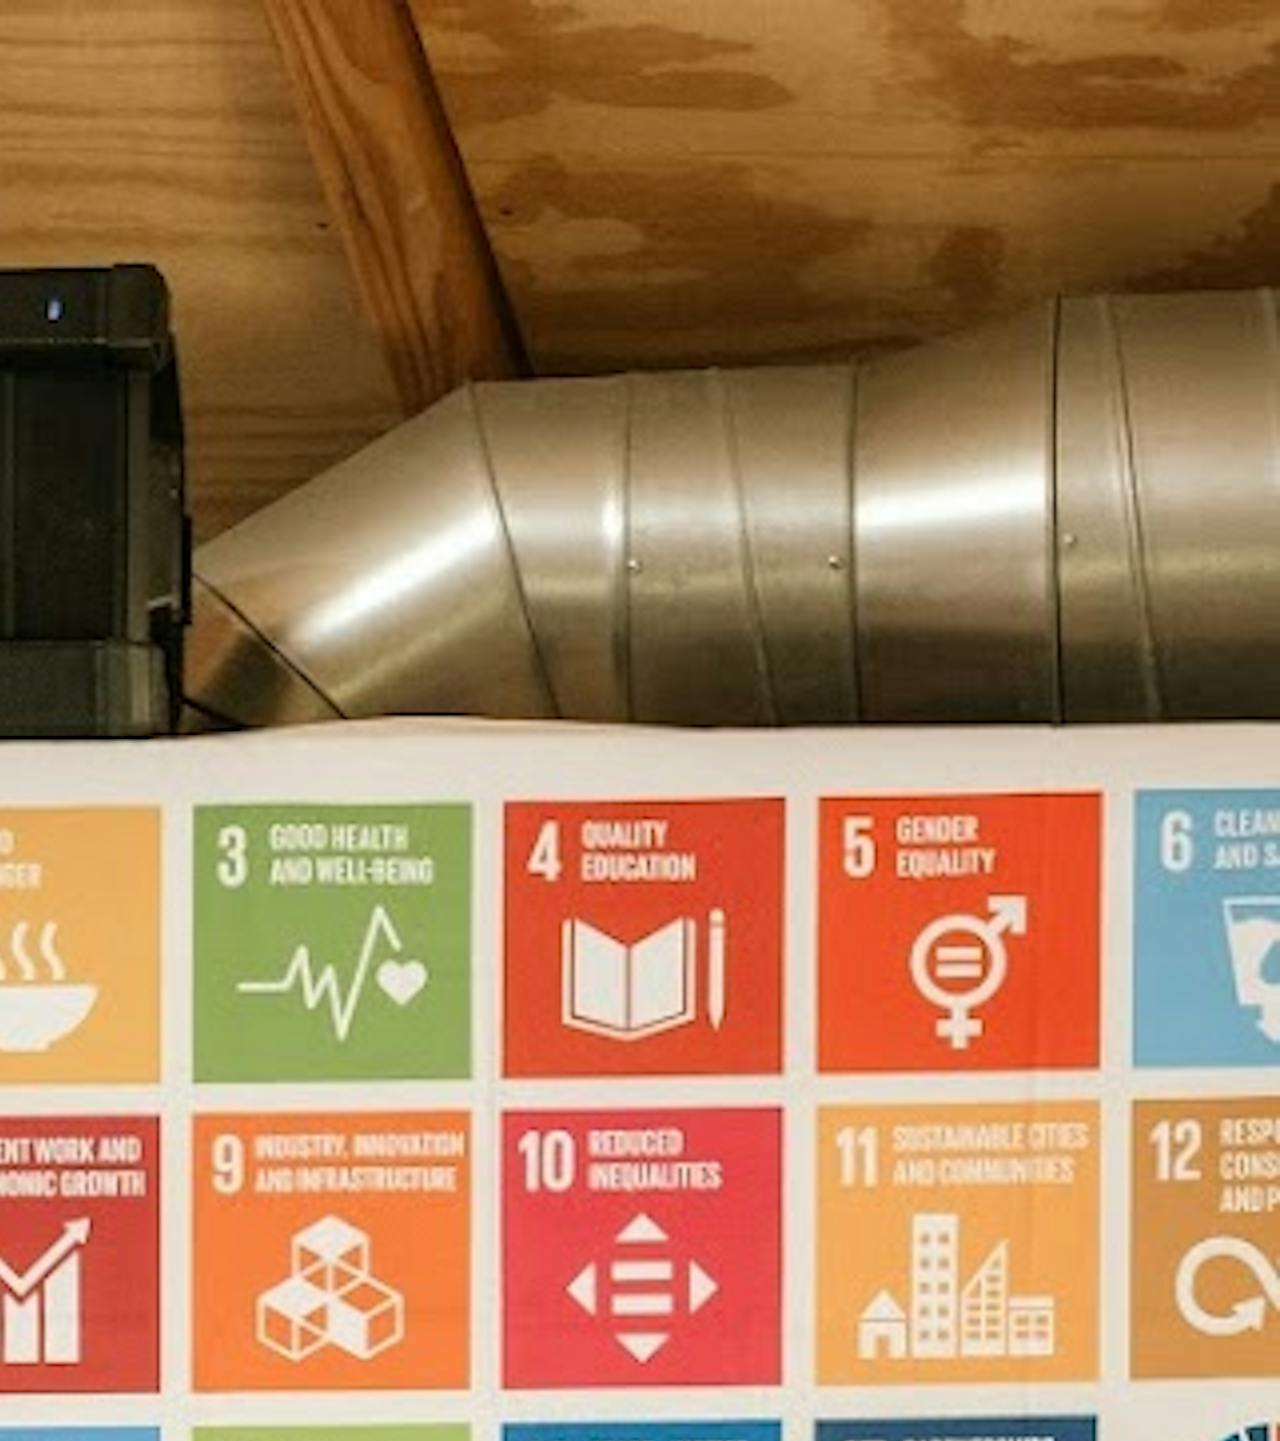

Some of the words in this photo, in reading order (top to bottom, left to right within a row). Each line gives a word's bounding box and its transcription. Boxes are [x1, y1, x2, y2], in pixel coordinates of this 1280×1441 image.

[269, 823, 329, 850] GOOD
[331, 823, 409, 850] HEALTH
[580, 819, 669, 849] QUALITY
[895, 815, 979, 844] GENDER
[1161, 810, 1193, 873] 6
[216, 824, 248, 888] 3
[526, 819, 562, 882] 4
[842, 815, 876, 879] 5
[1212, 841, 1260, 870] AND
[269, 856, 314, 886] AND
[580, 852, 697, 882] EDUCATION
[895, 847, 997, 880] EQUALITY
[33, 1135, 95, 1165] WORK
[96, 1134, 143, 1165] AND
[587, 1128, 685, 1157] REDUCED
[836, 1125, 878, 1188] 11
[1148, 1119, 1203, 1182] 12
[211, 1133, 245, 1195] 9
[517, 1128, 576, 1193] 10
[587, 1161, 723, 1191] INEQUALITIES
[59, 1168, 147, 1198] GROWTH
